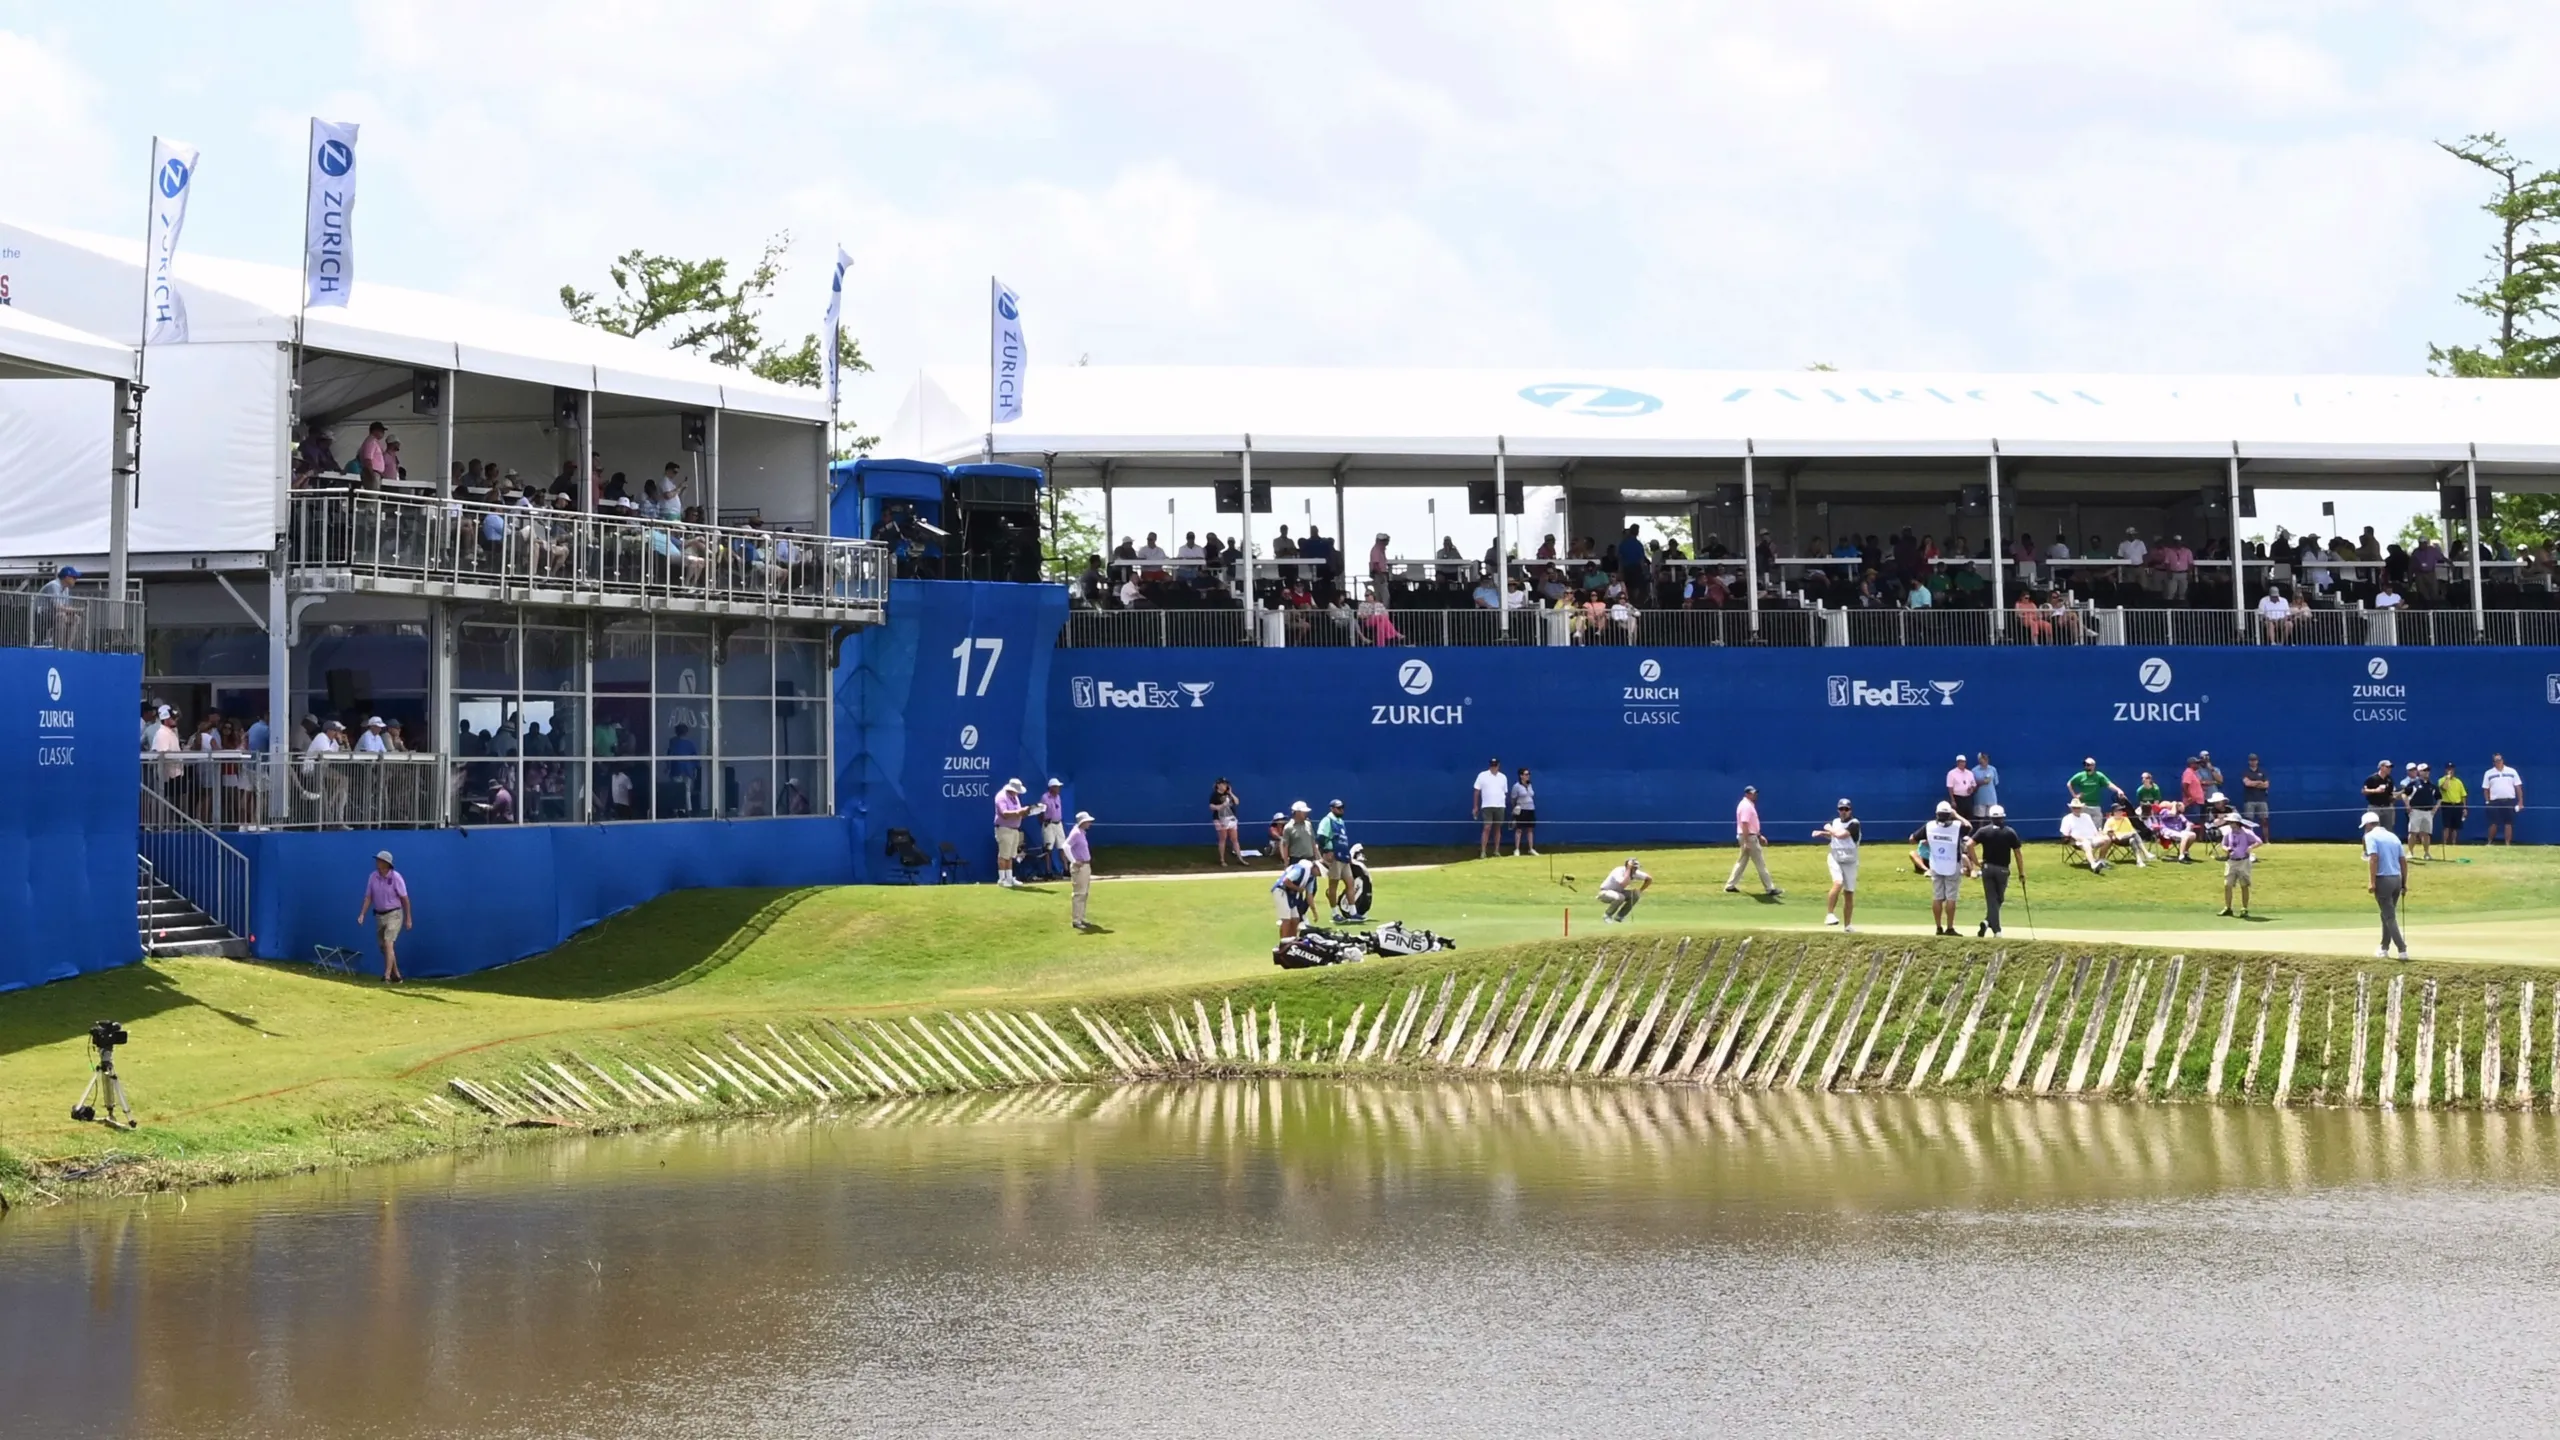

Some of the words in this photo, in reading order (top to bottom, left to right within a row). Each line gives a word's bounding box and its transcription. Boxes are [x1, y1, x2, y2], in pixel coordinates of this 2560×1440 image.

[320, 190, 342, 293] ZURICH
[2, 247, 21, 258] the
[999, 330, 1018, 407] ZURICH
[952, 637, 1003, 696] 17
[1098, 681, 1180, 708] FedEx
[1624, 687, 1679, 700] ZURICH
[1853, 680, 1930, 706] FedEx
[2353, 684, 2406, 698] ZURICH
[39, 711, 74, 728] ZURICH
[1371, 704, 1463, 725] ZURICH
[1623, 711, 1680, 725] CLASSIC
[2113, 702, 2201, 722] ZURICH
[2353, 708, 2407, 722] CLASSIC
[38, 747, 75, 766] CLASSIC
[943, 757, 990, 770] ZURICH
[942, 782, 990, 798] CLASSIC
[1384, 932, 1423, 951] PING
